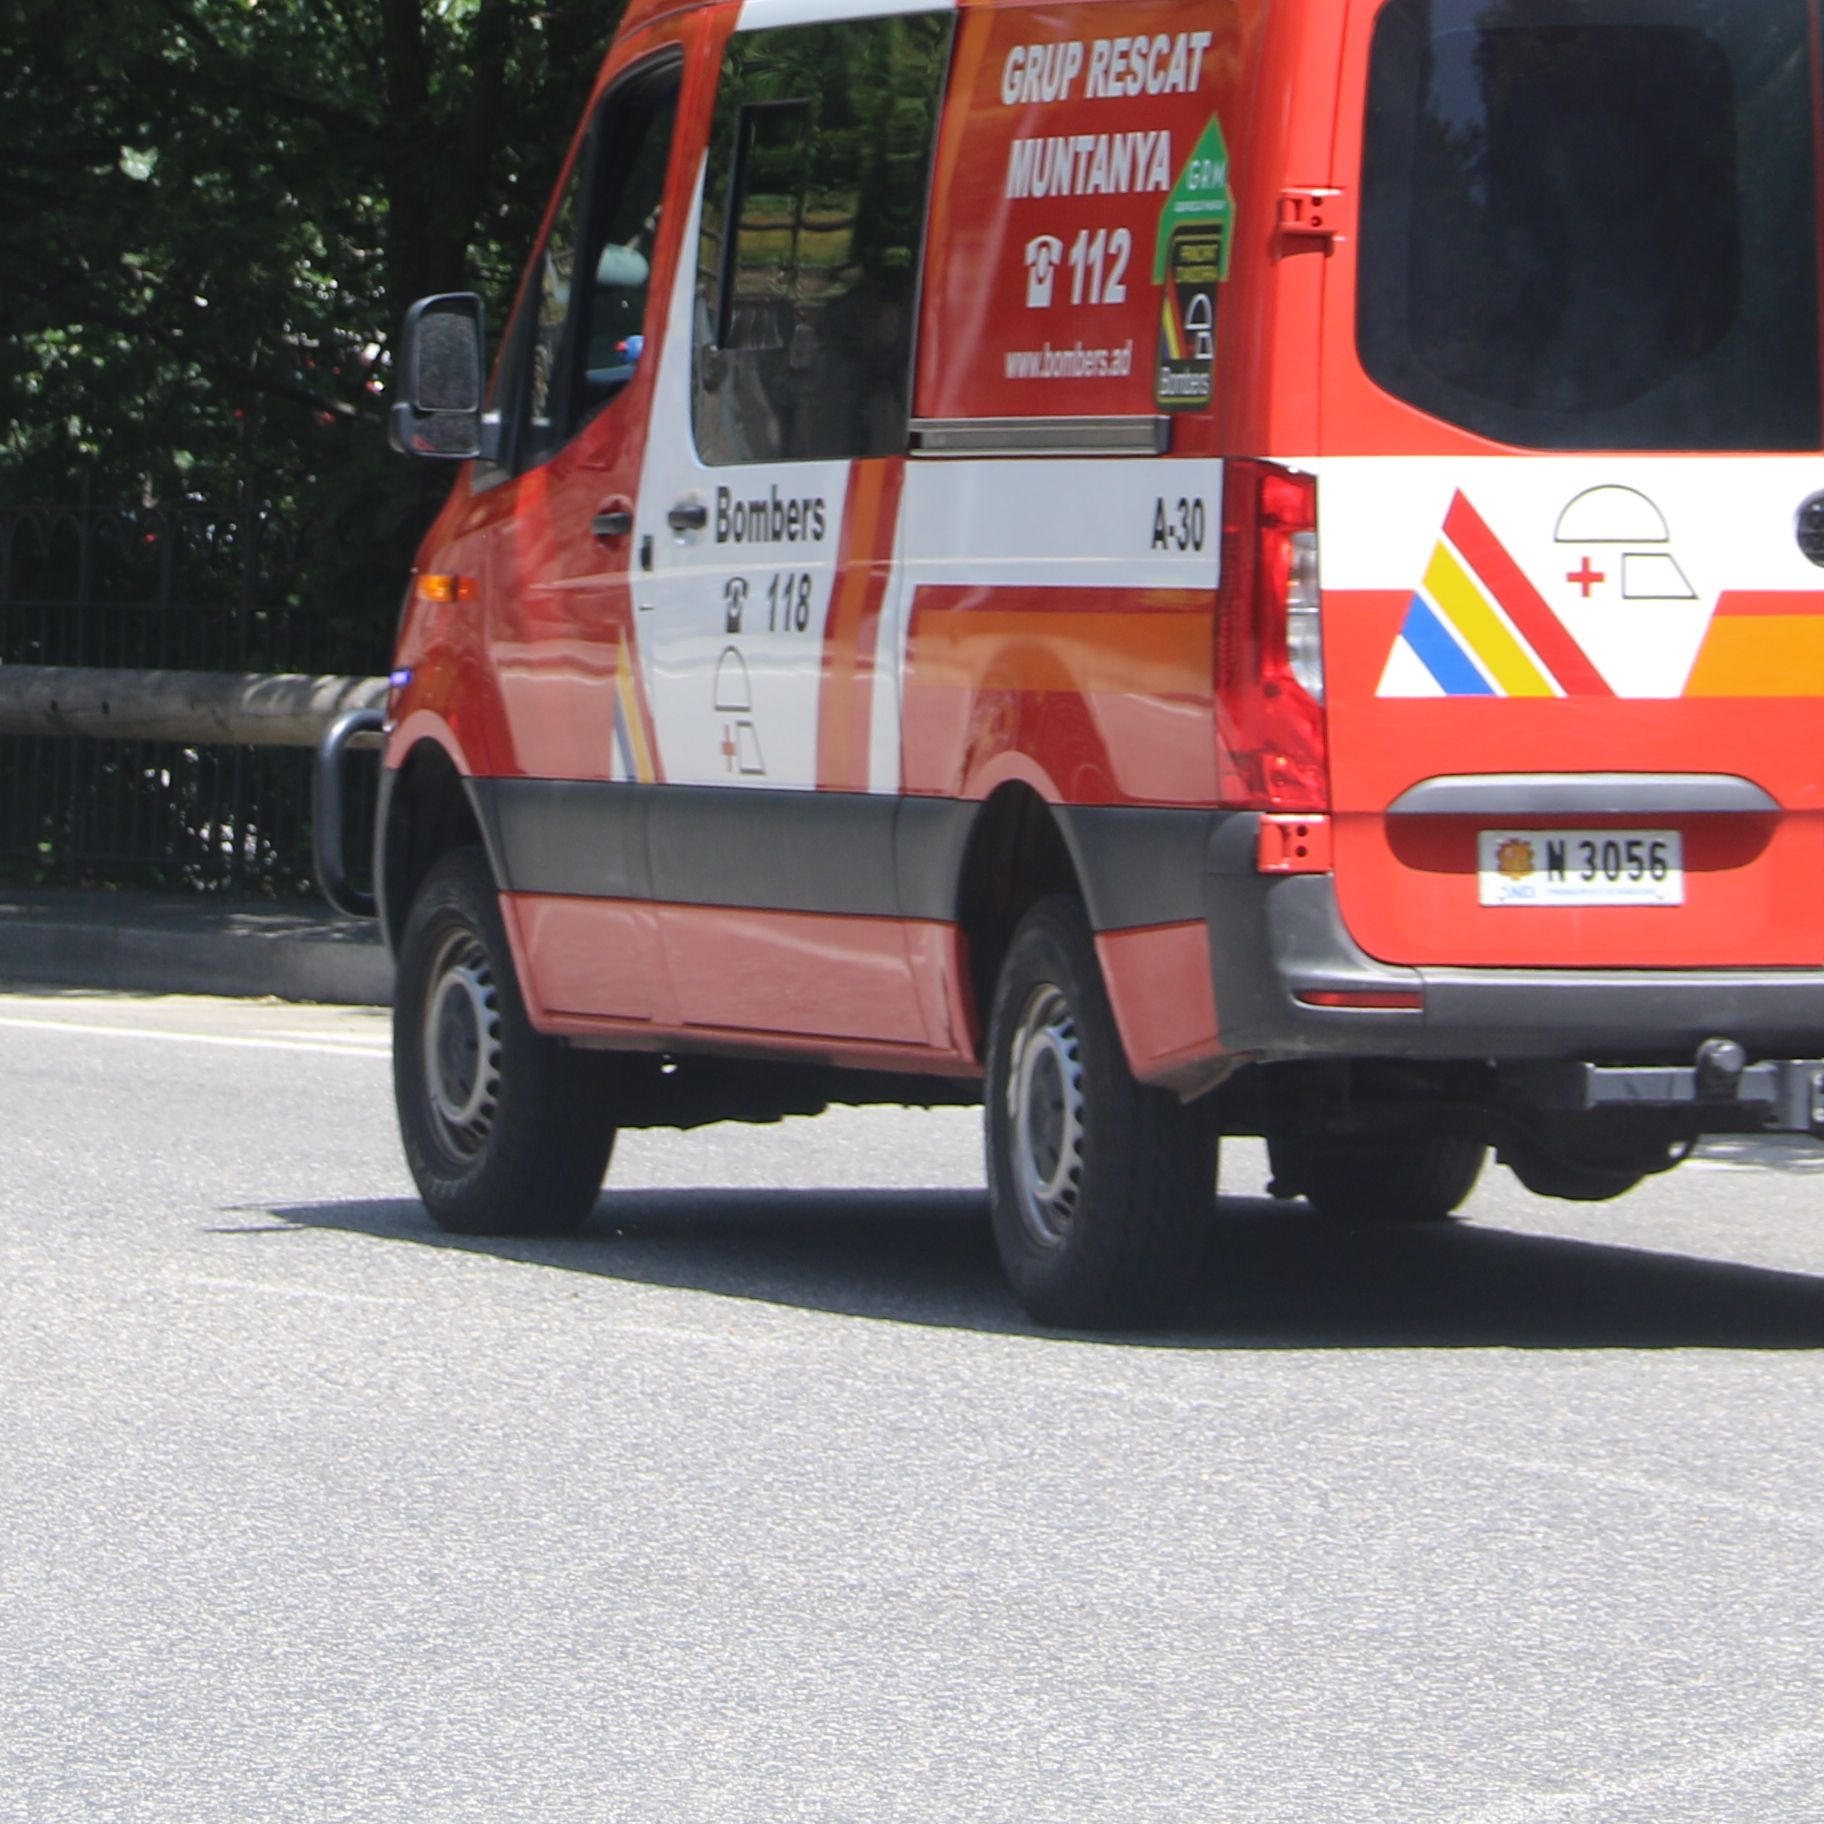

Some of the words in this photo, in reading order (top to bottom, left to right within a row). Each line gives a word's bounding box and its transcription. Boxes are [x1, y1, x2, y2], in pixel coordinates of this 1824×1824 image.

[1001, 40, 1083, 105] GRUP
[1084, 31, 1213, 99] RESCAT
[1005, 130, 1170, 199] MUNTANYA
[1187, 159, 1226, 191] GRM
[1068, 228, 1132, 305] 112
[1005, 339, 1133, 379] www.bombers.ad
[716, 484, 825, 543] Bombers
[1151, 497, 1205, 552] A-30
[768, 573, 812, 632] 118
[1547, 839, 1566, 882] N
[1579, 839, 1668, 882] 3056
